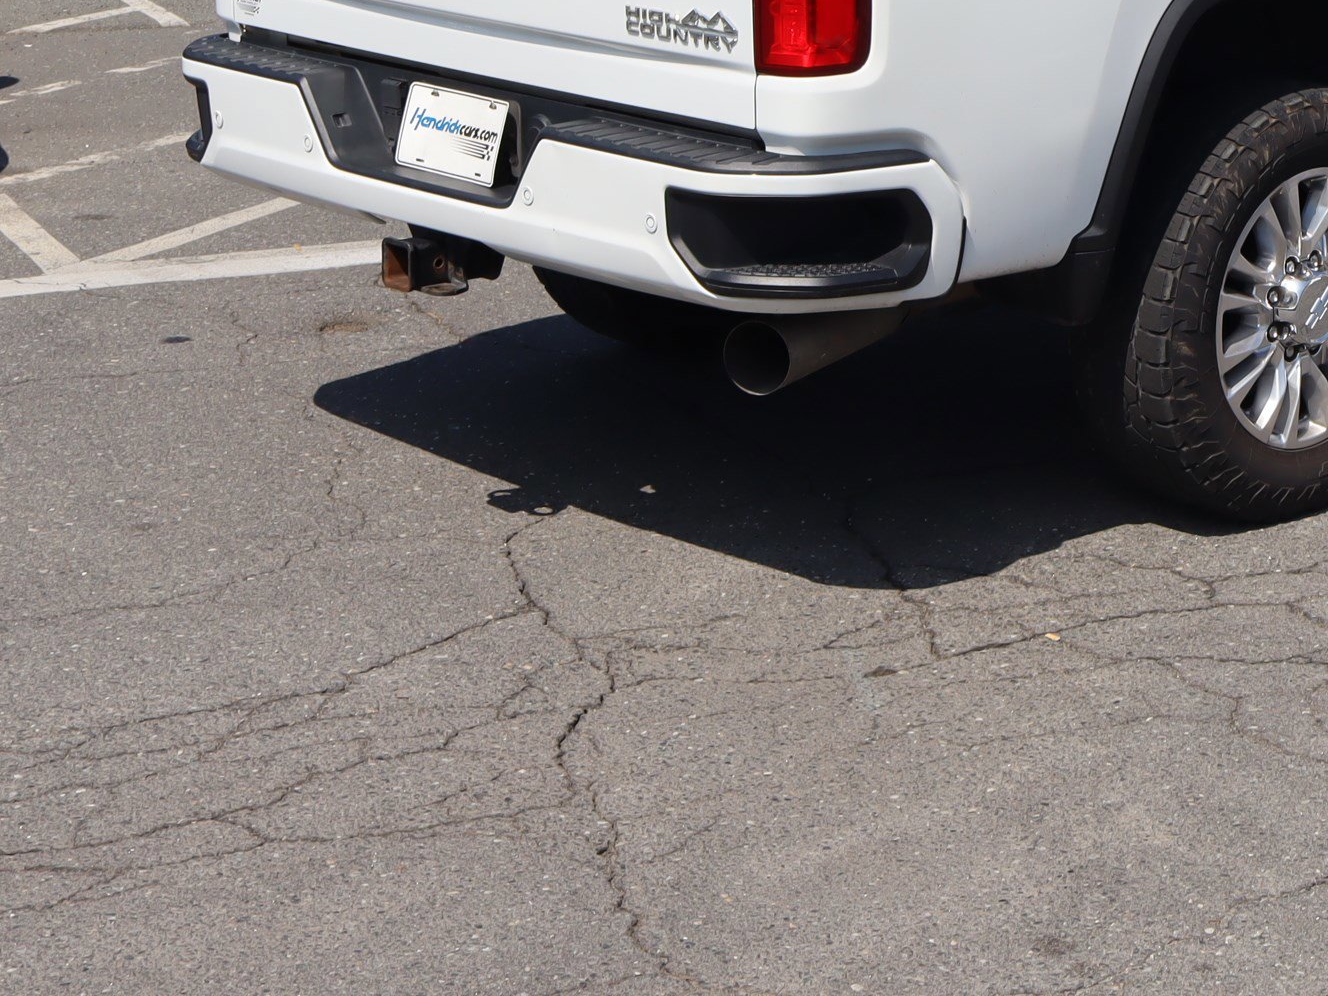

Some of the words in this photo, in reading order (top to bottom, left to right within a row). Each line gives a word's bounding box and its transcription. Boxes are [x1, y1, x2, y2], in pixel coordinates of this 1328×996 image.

[625, 4, 682, 25] HIGH
[625, 19, 739, 53] COUNTRY
[409, 106, 498, 144] Hendrickcars.com
